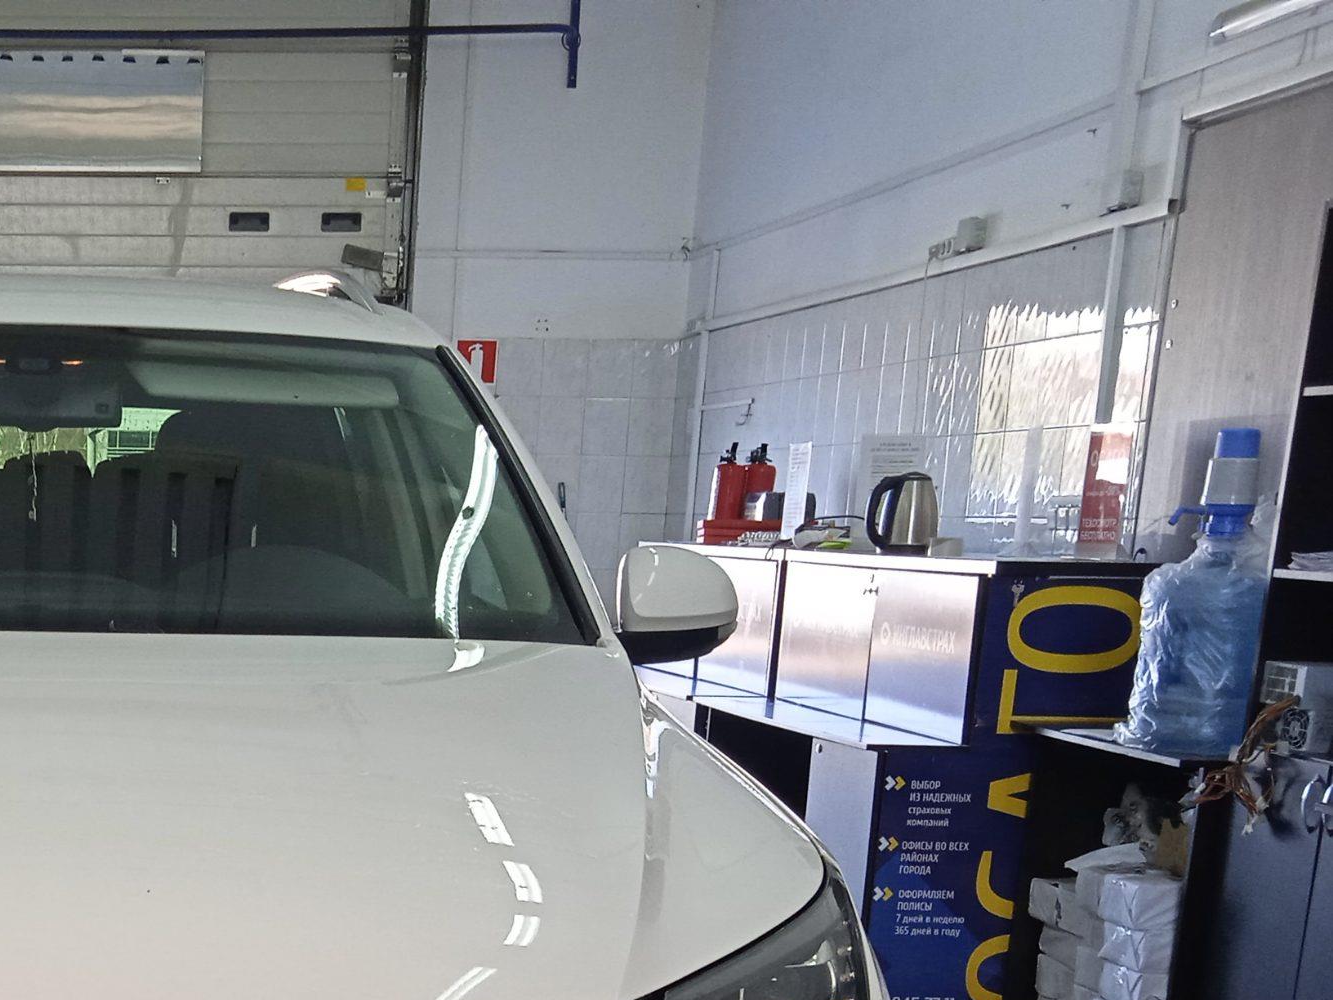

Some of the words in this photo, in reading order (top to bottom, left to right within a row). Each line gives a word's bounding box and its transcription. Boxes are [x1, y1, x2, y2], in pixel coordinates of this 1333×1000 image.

[911, 780, 941, 790] ВЫБОР
[909, 793, 921, 802] ИЗ
[922, 793, 971, 803] НАДЕЖНЫХ
[908, 807, 952, 815] страховых
[907, 818, 949, 827] компаний
[902, 841, 933, 851] ОФИСЫ
[935, 842, 946, 851] ВО
[949, 842, 969, 851] ВСЕХ
[900, 852, 939, 863] РАЙОНАХ
[899, 866, 931, 875] ГОРОДА
[898, 890, 955, 900] ОФОРМЛЯЕМ
[896, 902, 933, 911] ПОЛИСЫ
[896, 914, 901, 923] 7
[902, 915, 924, 924] дней
[933, 916, 965, 924] неделю
[894, 926, 909, 935] 365
[910, 926, 932, 936] дней
[941, 928, 961, 938] году
